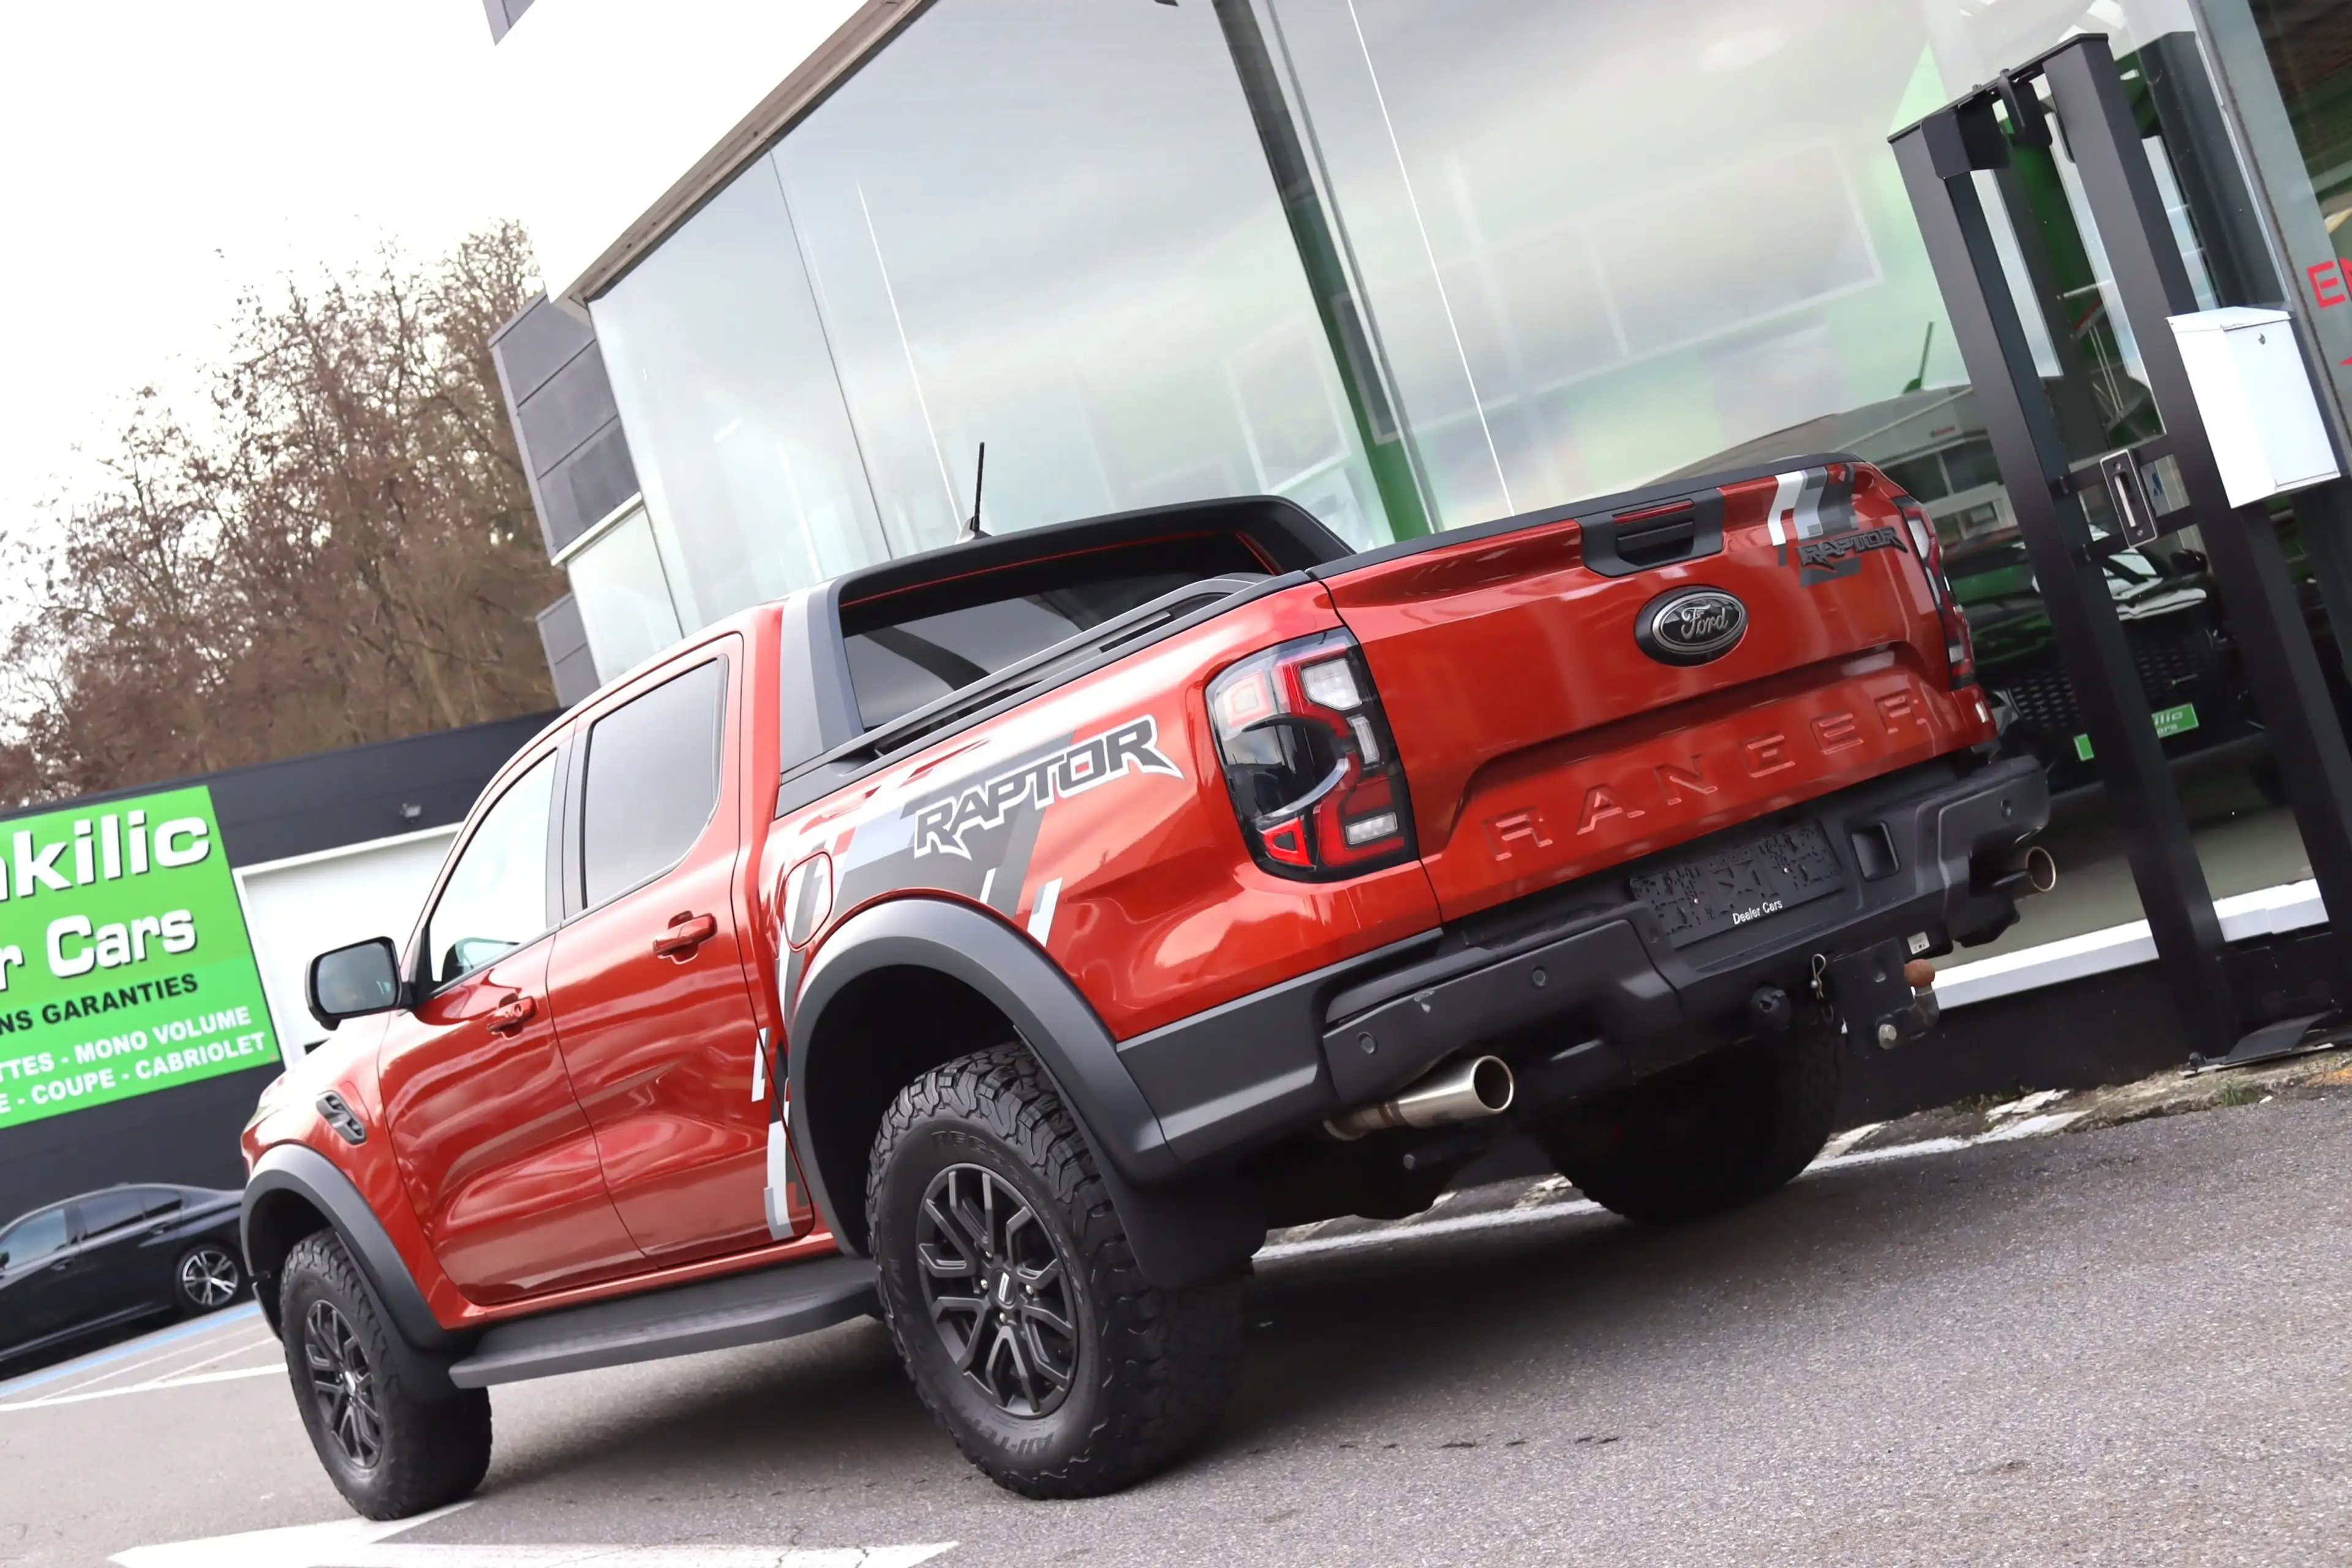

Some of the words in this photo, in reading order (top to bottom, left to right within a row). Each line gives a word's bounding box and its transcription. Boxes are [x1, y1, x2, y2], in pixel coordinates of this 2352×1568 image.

[1798, 527, 1909, 570] RAPTOR
[1681, 603, 1729, 640] Ford
[913, 714, 1185, 859] RAPTOR
[1482, 693, 1927, 862] RANGER
[1732, 908, 1760, 925] Dealer
[1762, 900, 1782, 913] Cars
[46, 909, 197, 978] Cars
[42, 973, 198, 1024] GARANTIES
[74, 1030, 148, 1065] MONO
[152, 1006, 252, 1044] VOLUME
[31, 1068, 116, 1105] COUPE
[135, 1031, 265, 1080] CABRIOLET
